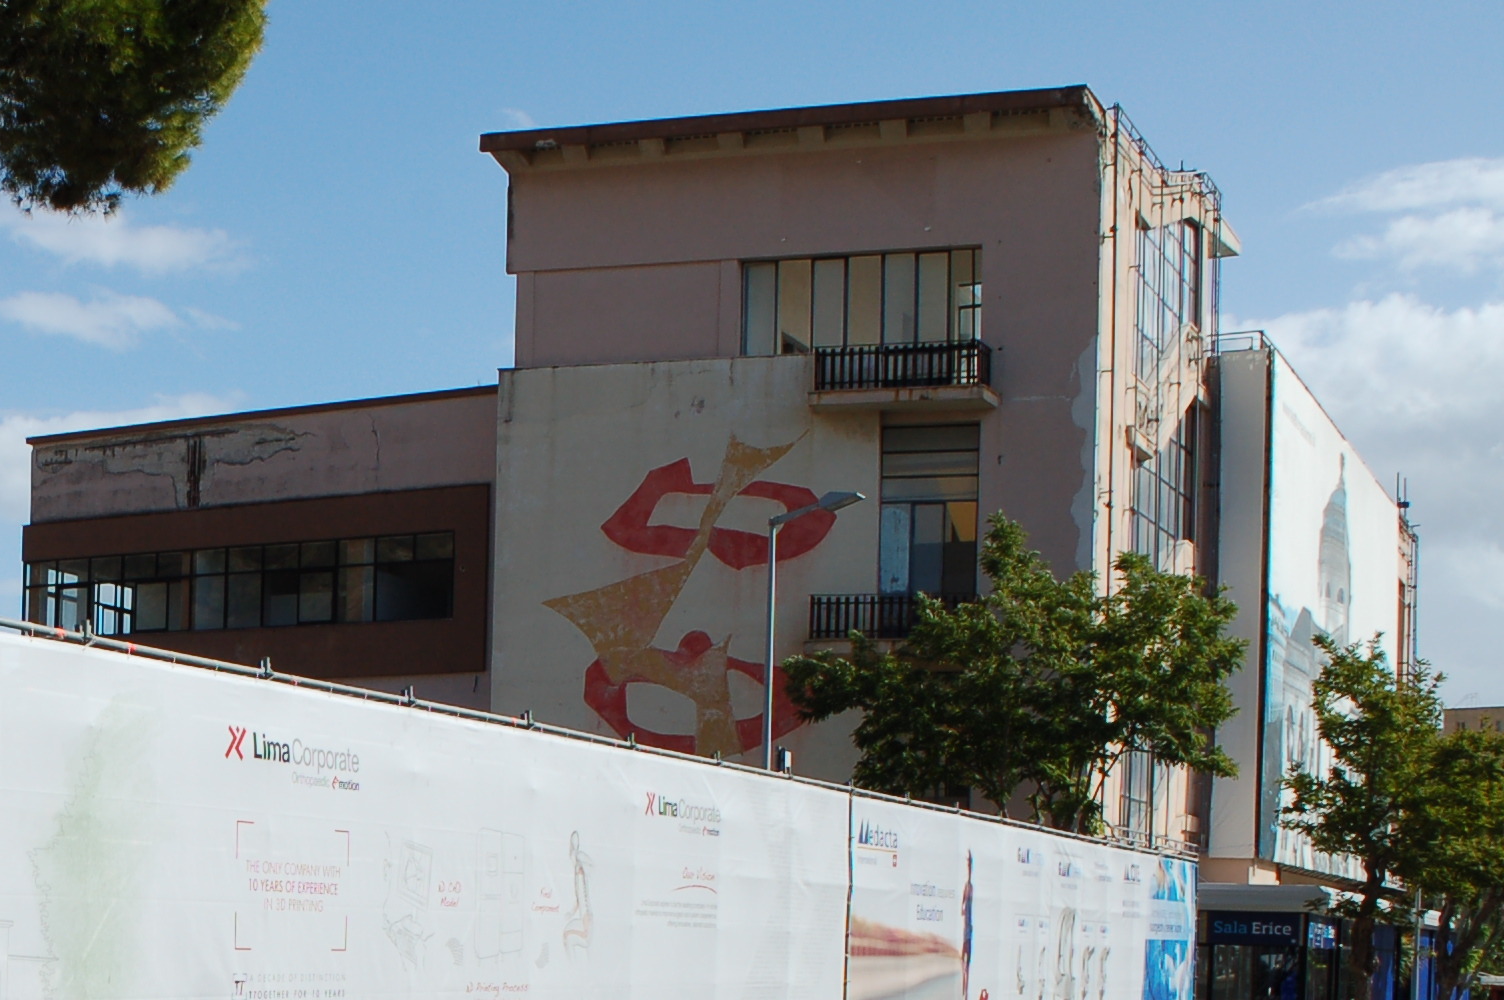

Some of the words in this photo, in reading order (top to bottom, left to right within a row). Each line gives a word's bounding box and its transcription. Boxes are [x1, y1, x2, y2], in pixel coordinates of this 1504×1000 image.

[857, 817, 898, 849] Medacta
[246, 859, 260, 873] THE
[262, 861, 282, 874] ONLY
[284, 862, 320, 877] COMPANY
[322, 865, 341, 878] WITH
[249, 878, 259, 891] 10
[260, 879, 283, 892] YEARS
[285, 880, 296, 893] OF
[298, 881, 338, 896] EXPERIENCE
[263, 898, 273, 910] IN
[288, 898, 324, 912] PRINTING
[1214, 920, 1248, 934] Sala
[1251, 921, 1292, 935] Erice
[293, 990, 307, 998] FOR
[324, 989, 345, 998] YEARS
[502, 981, 530, 992] Process
